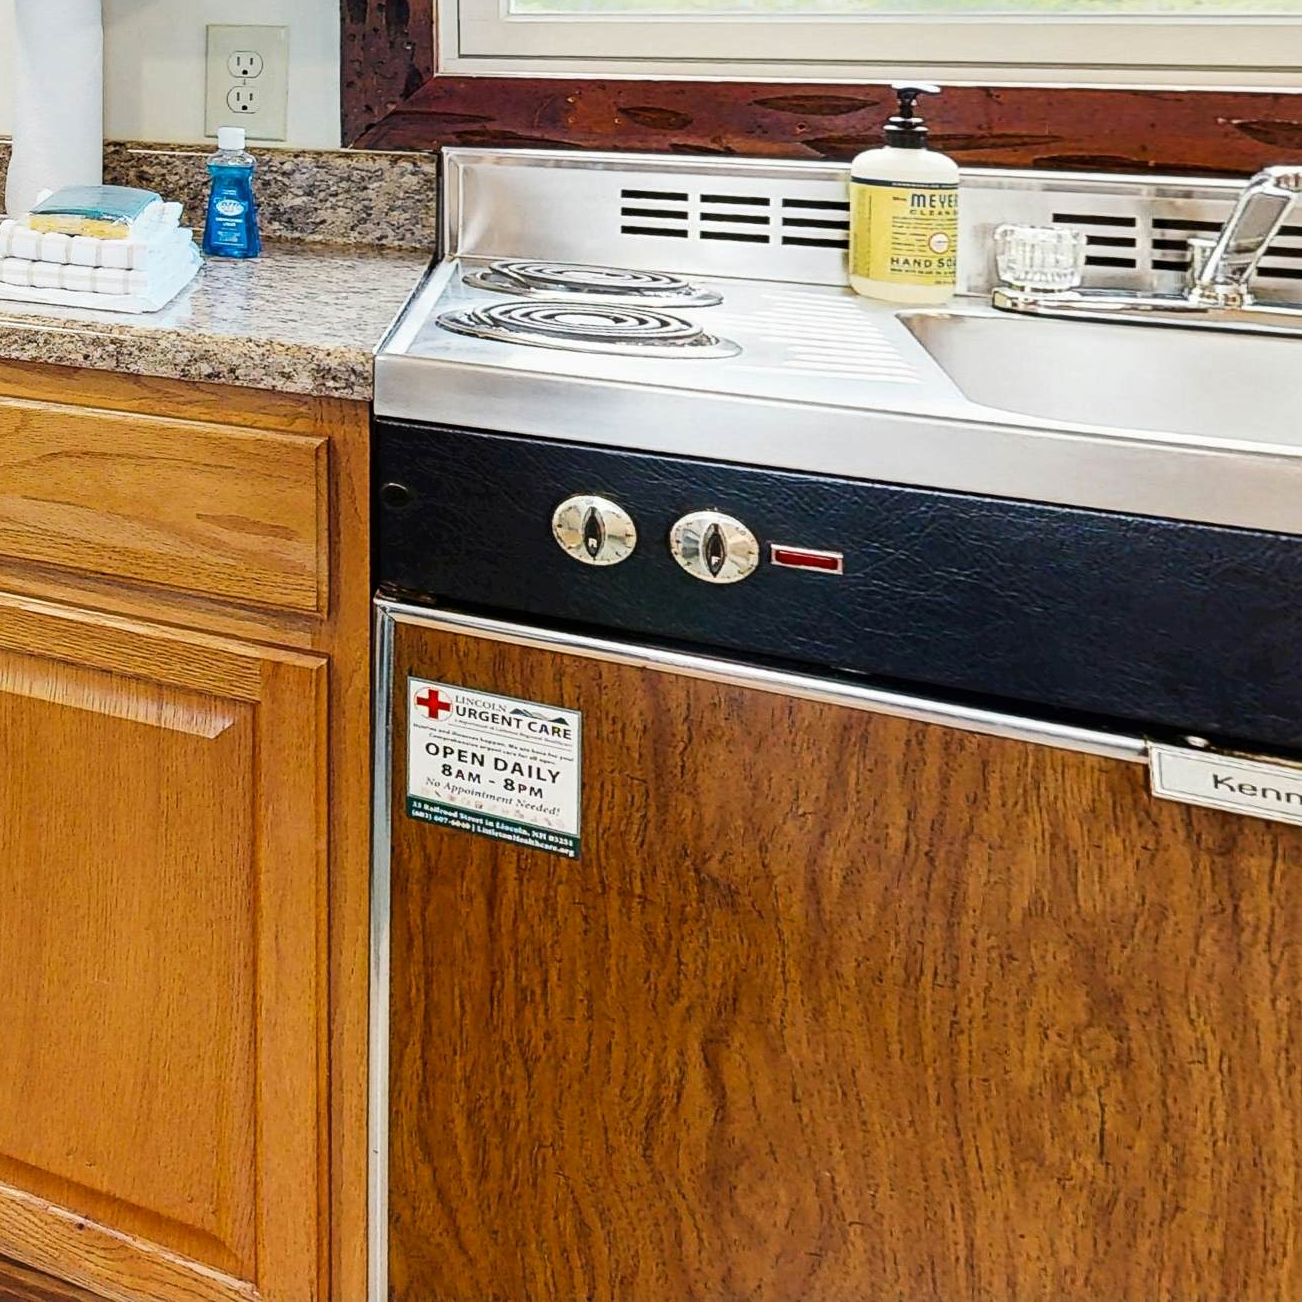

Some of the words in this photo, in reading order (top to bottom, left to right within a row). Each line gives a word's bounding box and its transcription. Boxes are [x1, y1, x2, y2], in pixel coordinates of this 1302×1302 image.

[890, 256, 933, 268] HAND
[455, 695, 507, 712] LINCOLN
[456, 705, 523, 729] URGENT
[528, 721, 572, 740] CARE
[425, 742, 485, 767] OPEN
[494, 757, 560, 784] DAILY
[425, 777, 441, 788] No
[443, 781, 513, 805] Appointment
[516, 798, 561, 817] Needed!
[441, 763, 481, 784] 8AM
[503, 778, 543, 799] 8PM
